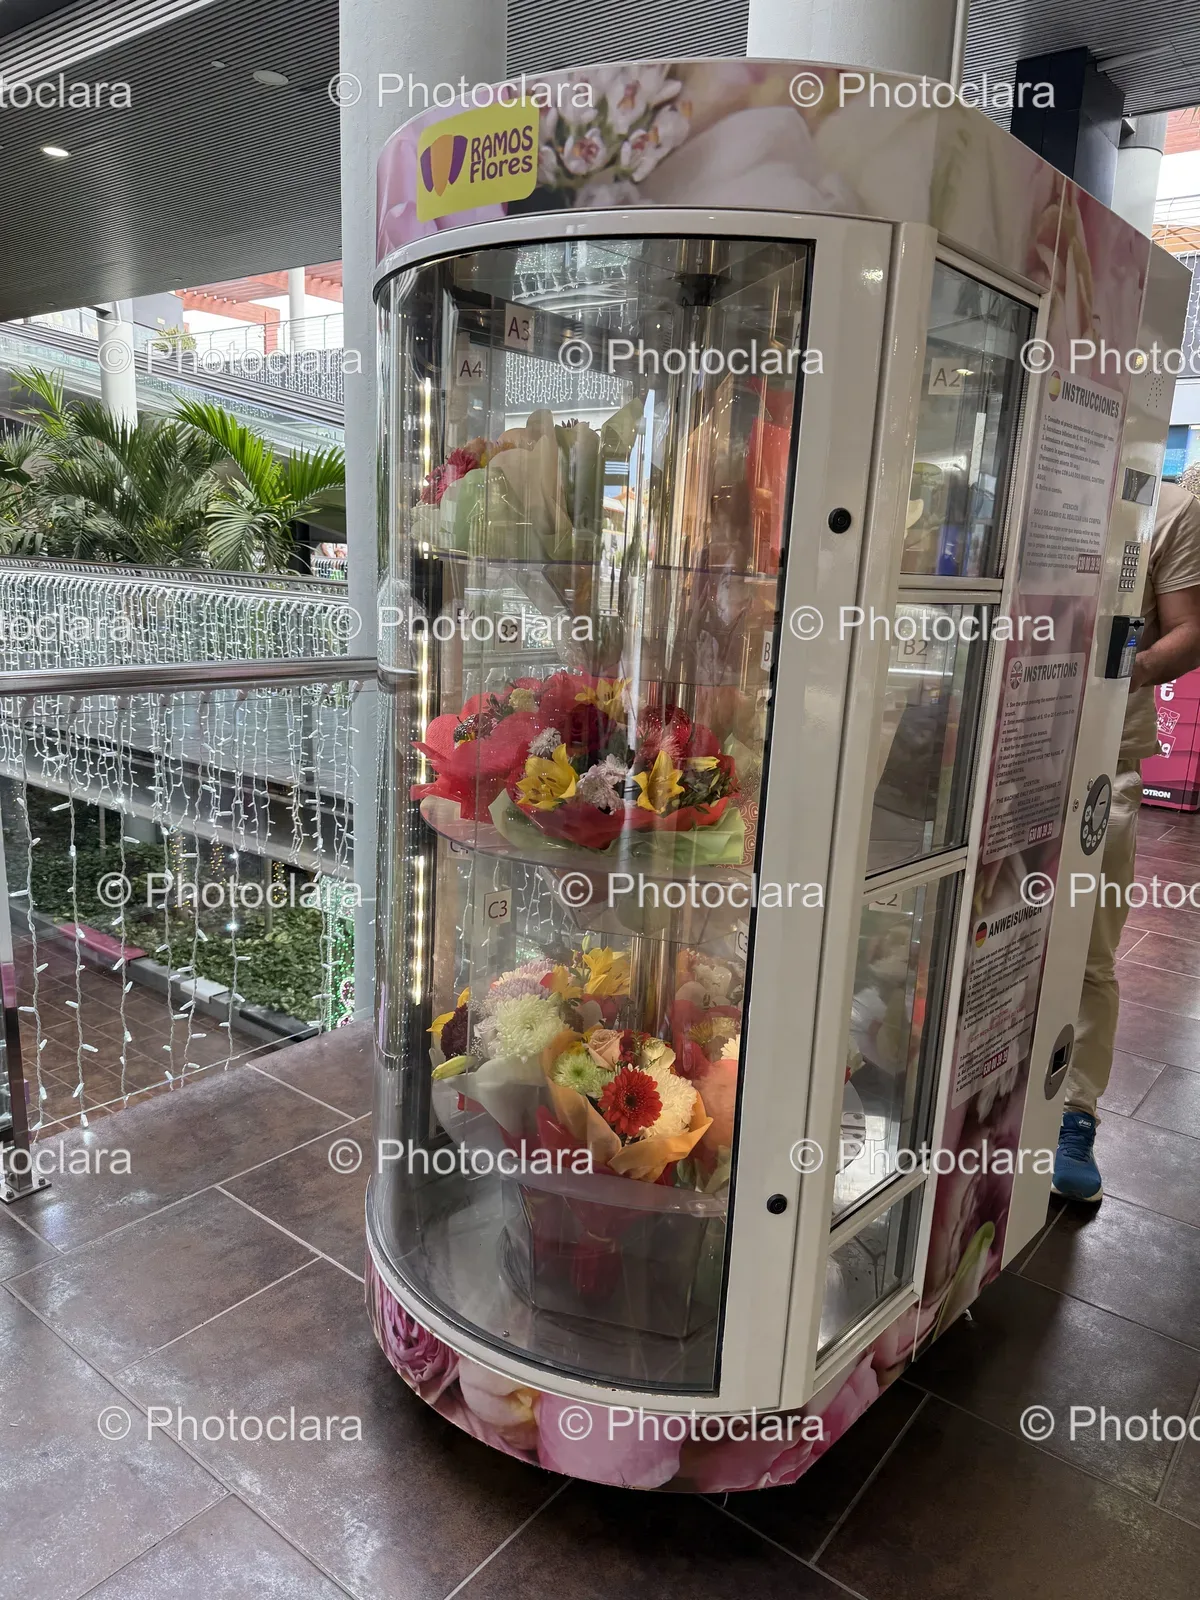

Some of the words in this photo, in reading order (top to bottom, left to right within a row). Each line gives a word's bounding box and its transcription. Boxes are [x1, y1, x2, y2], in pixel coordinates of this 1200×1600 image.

[471, 125, 533, 162] RAMOS
[470, 155, 533, 184] Flores
[507, 316, 531, 341] A3
[459, 359, 483, 378] A4
[932, 367, 960, 387] A2
[1061, 381, 1120, 418] INSTRUCCIONES
[903, 639, 928, 656] B2
[1023, 662, 1078, 682] INSTRUCTIONS
[1142, 788, 1171, 799] OTRON
[488, 900, 507, 919] C3
[988, 900, 1043, 938] ANWEISUNGEN
